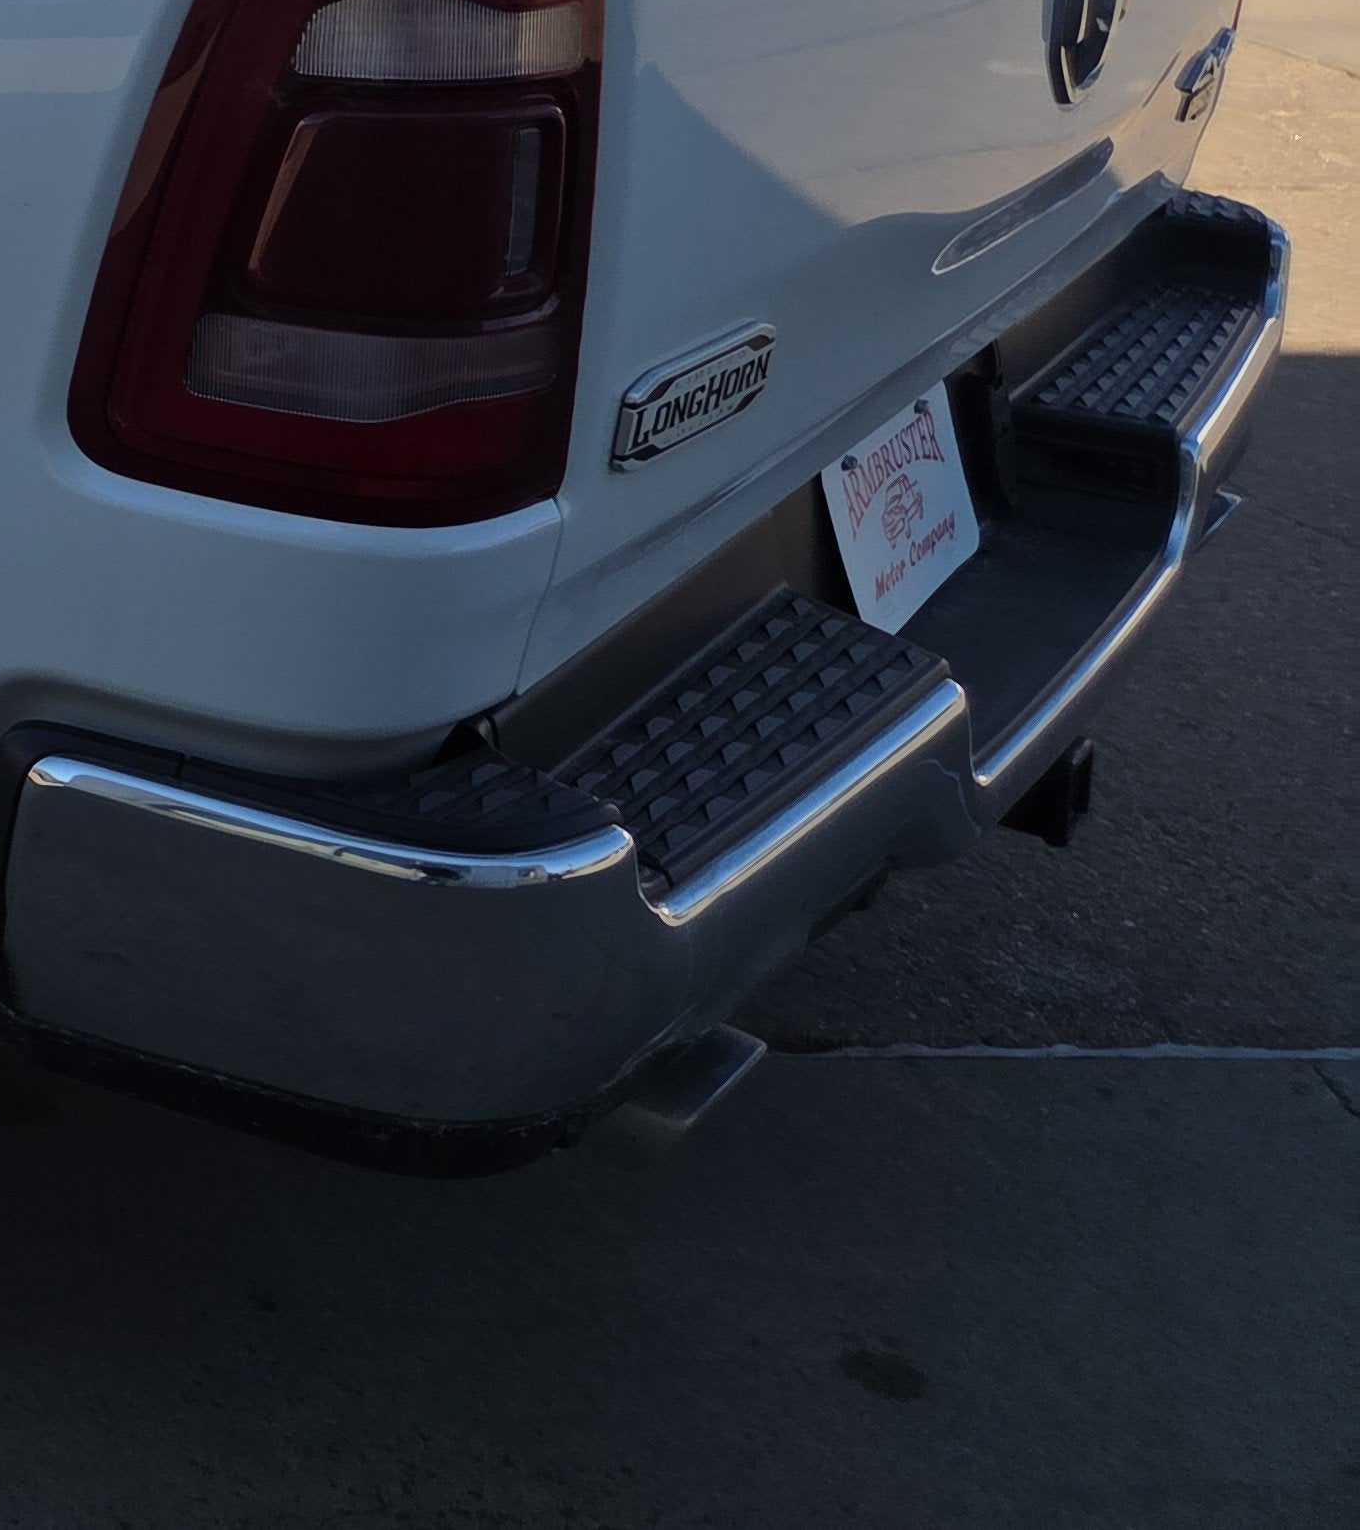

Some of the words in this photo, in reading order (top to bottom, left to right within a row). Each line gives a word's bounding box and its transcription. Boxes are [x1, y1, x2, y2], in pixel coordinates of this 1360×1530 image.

[628, 348, 773, 451] LONGHORN
[842, 409, 946, 541] ARMBRUSTER
[875, 558, 907, 603] Motor
[908, 510, 956, 568] Company
